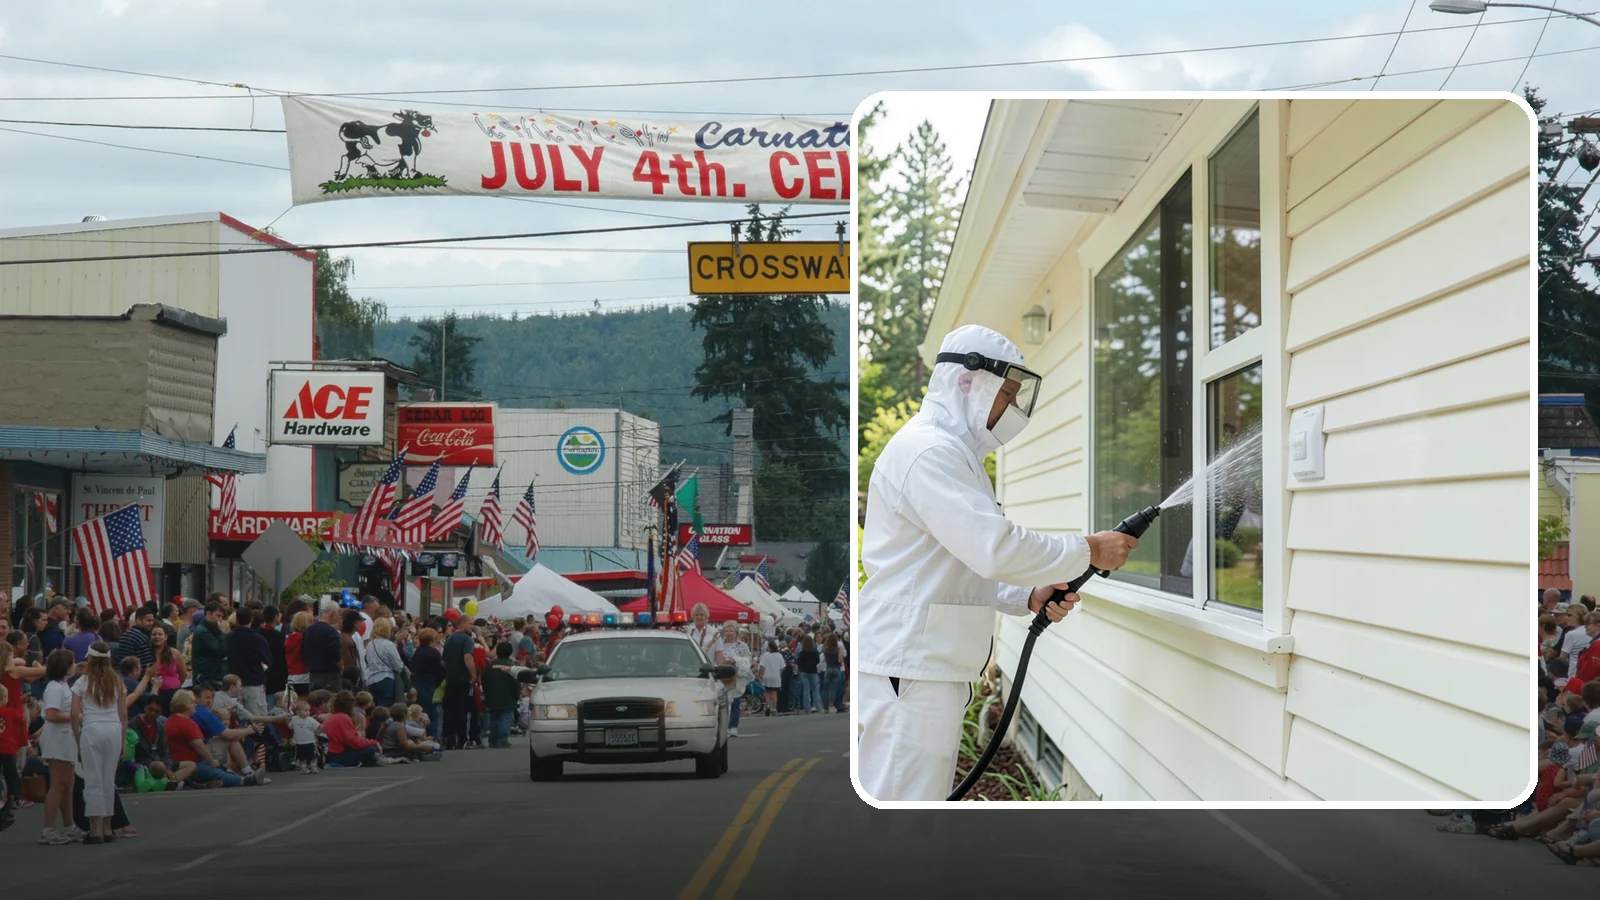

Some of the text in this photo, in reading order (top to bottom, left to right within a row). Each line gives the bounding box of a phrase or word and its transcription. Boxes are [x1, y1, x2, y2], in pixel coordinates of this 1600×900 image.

[481, 141, 604, 192] JULY
[632, 150, 746, 197] 4th.
[697, 254, 850, 280] CROSSWA
[282, 380, 373, 420] ACE
[406, 409, 485, 422] CEDAR LOG
[284, 421, 370, 436] Hardware
[96, 485, 124, 495] Vincent
[126, 485, 135, 495] de
[137, 486, 155, 495] Paul
[688, 526, 741, 535] CRNATION
[699, 535, 730, 543] GLASS
